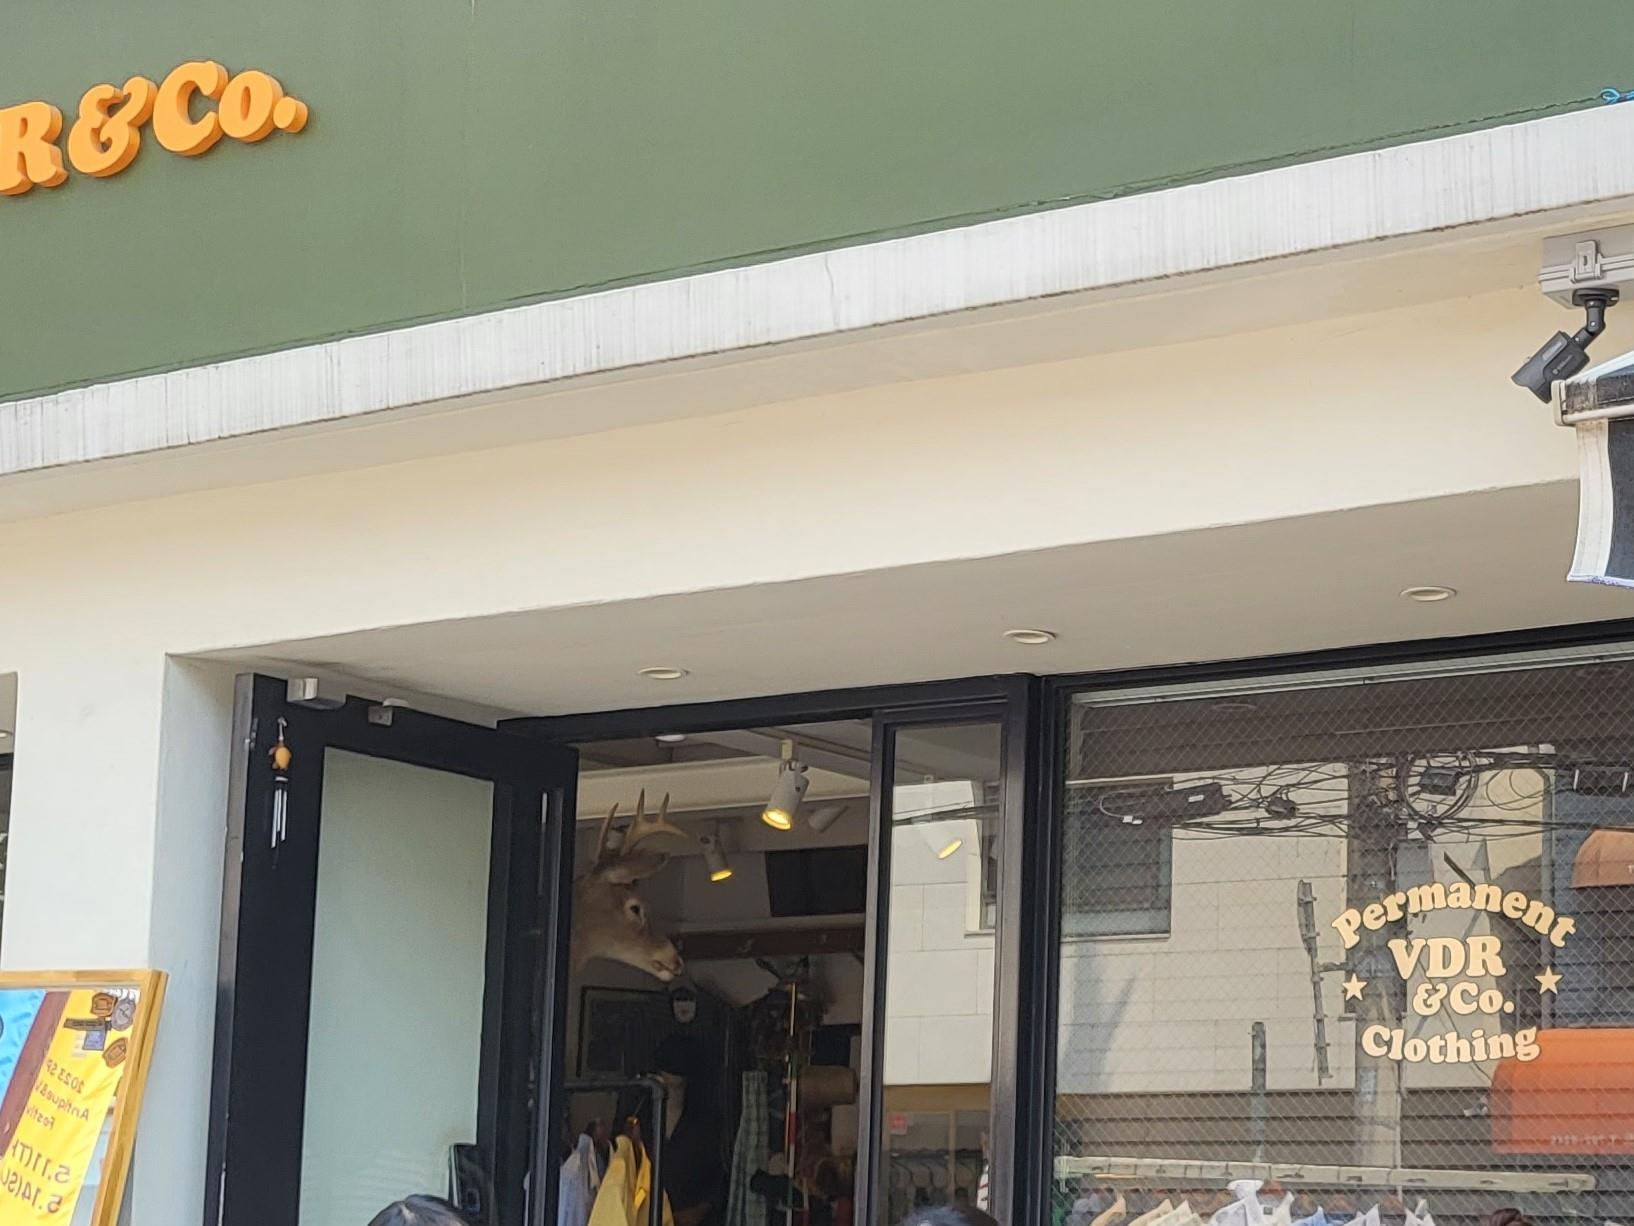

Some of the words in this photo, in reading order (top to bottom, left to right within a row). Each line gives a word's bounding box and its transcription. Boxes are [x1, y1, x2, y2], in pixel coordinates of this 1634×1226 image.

[1331, 882, 1576, 949] Permanent
[1387, 935, 1507, 980] VDR
[1412, 981, 1515, 1016] &Co.
[1361, 1024, 1541, 1064] Clothing
